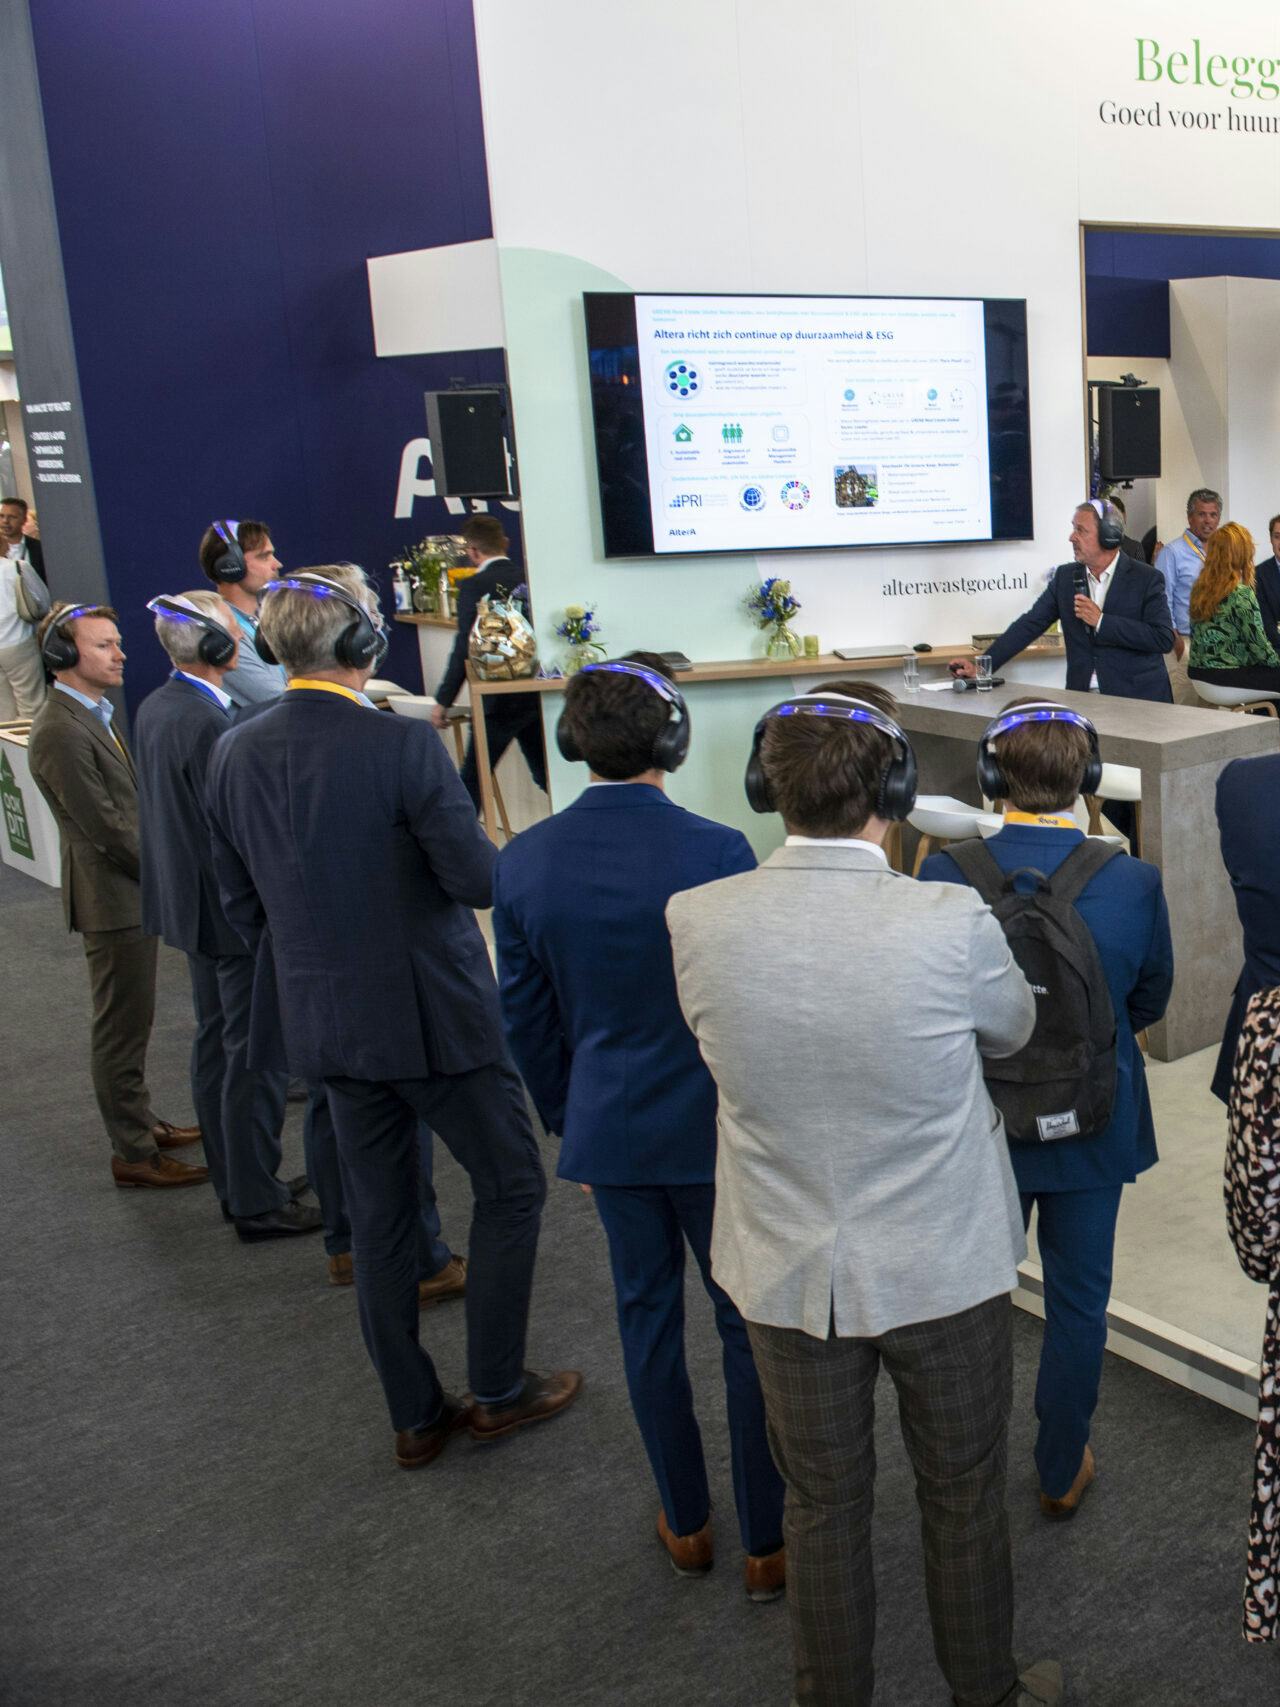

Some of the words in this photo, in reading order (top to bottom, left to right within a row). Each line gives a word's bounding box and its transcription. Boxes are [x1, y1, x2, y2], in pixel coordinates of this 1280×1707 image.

[1099, 99, 1162, 127] Goed
[1168, 109, 1221, 130] voor
[654, 329, 685, 339] Altera
[687, 329, 709, 340] richt
[713, 329, 732, 340] zich
[735, 330, 777, 340] continue
[780, 331, 793, 341] op
[795, 330, 863, 340] duurzaamheid
[866, 331, 873, 340] &
[876, 331, 894, 340] ESG
[681, 495, 702, 507] PRI
[882, 572, 1028, 596] alteravastgoed.nl
